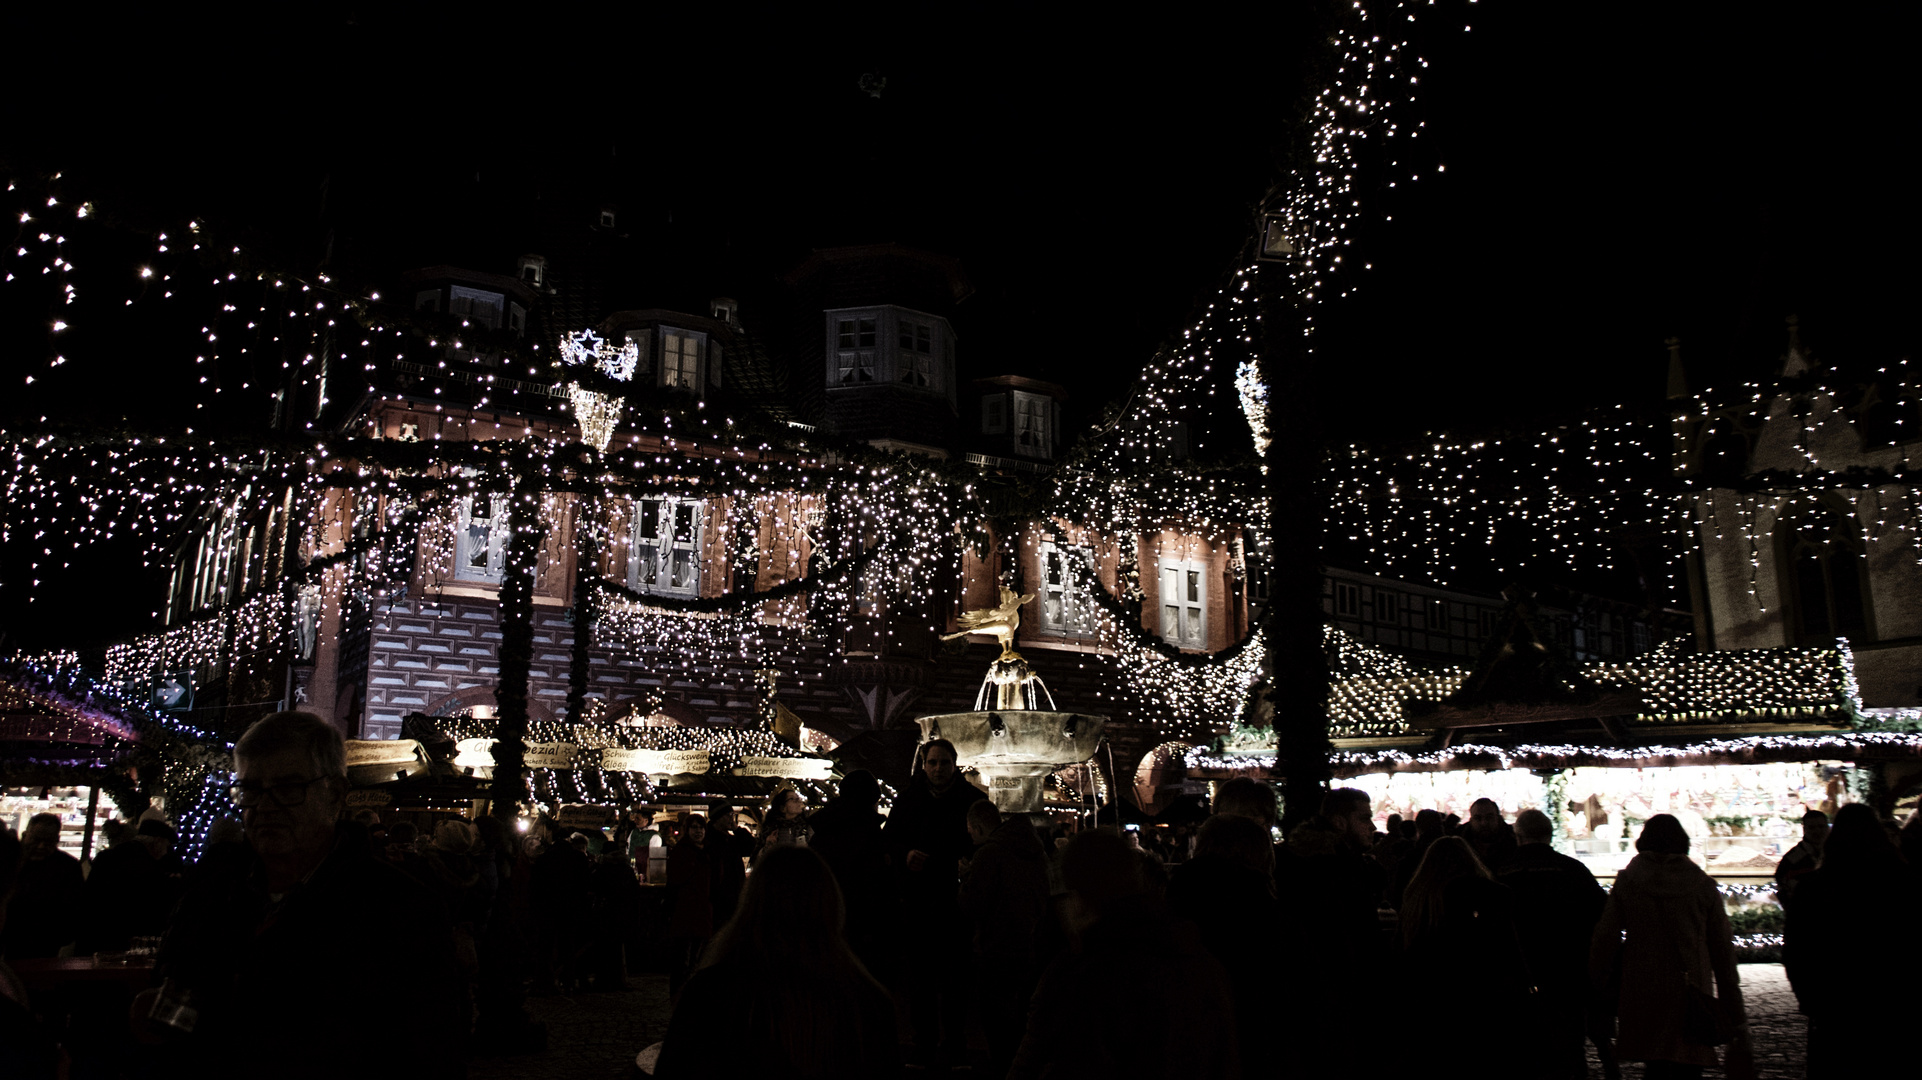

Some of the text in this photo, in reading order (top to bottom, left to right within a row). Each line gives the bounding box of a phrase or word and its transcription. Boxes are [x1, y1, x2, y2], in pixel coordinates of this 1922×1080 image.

[523, 744, 560, 756] pezial
[663, 751, 708, 762] Glückswein
[747, 757, 780, 767] Goslarer
[602, 759, 628, 771] Glögg
